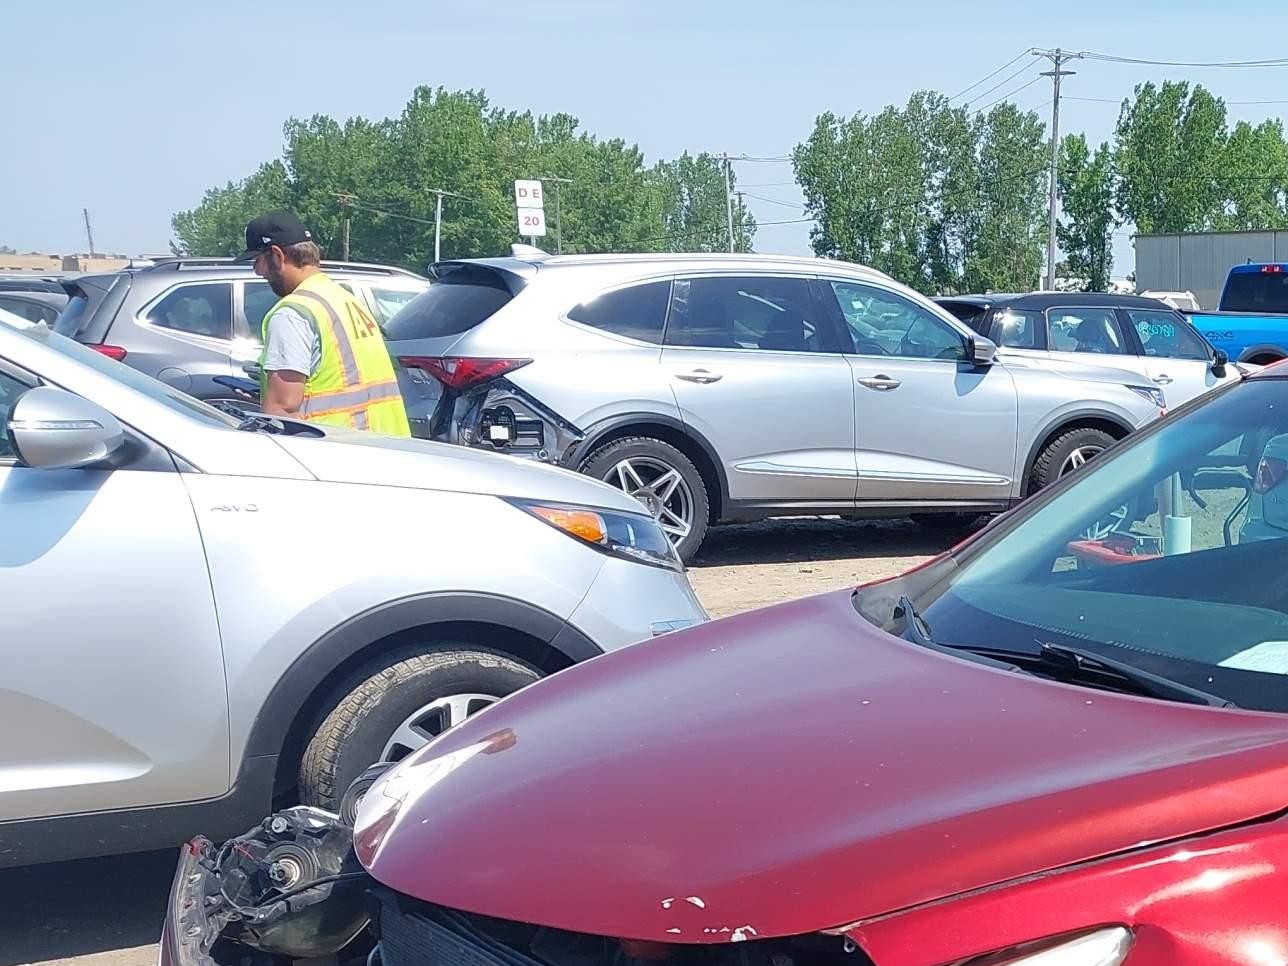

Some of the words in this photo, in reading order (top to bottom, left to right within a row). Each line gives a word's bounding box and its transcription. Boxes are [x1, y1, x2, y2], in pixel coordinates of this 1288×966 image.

[519, 188, 527, 197] D
[532, 189, 540, 198] E
[524, 216, 540, 226] 20
